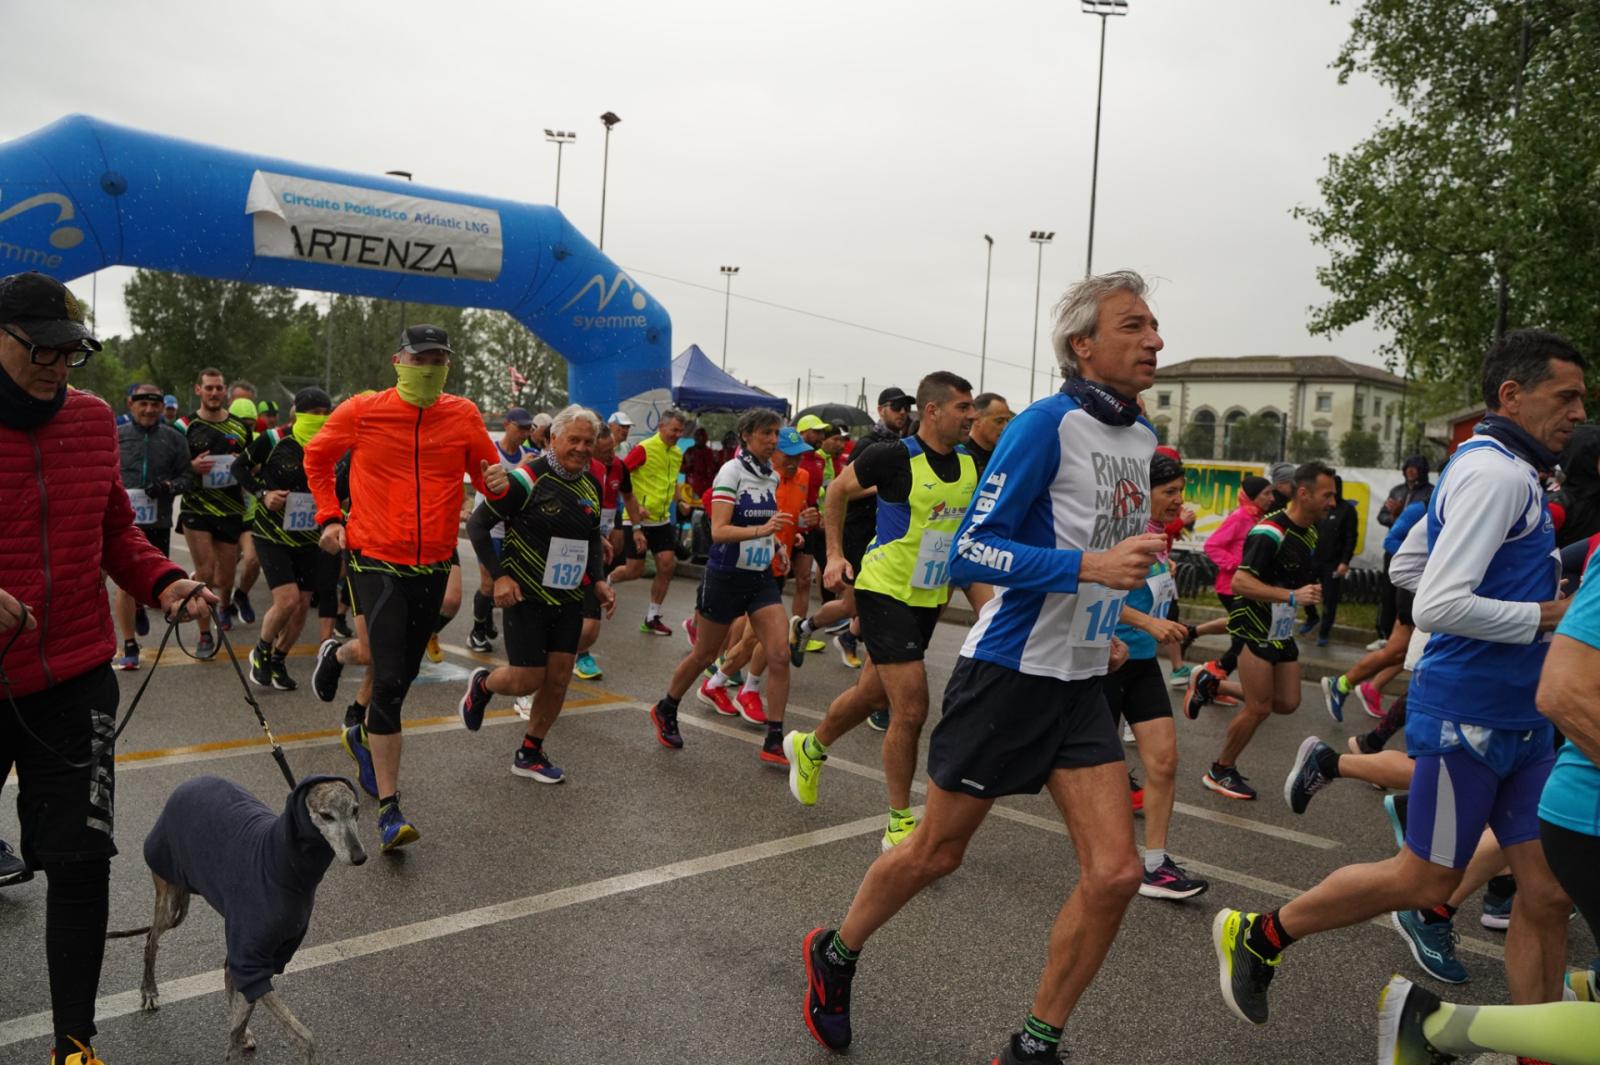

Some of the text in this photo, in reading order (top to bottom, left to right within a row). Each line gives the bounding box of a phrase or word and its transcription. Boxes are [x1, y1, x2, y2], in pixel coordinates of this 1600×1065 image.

[282, 191, 490, 235] Circuito Podistico Adriatic LNG
[572, 315, 648, 331] syemme
[134, 505, 155, 521] 37
[744, 546, 771, 567] 144
[551, 562, 582, 586] 132
[923, 560, 951, 585] 11
[1085, 597, 1122, 641] 14
